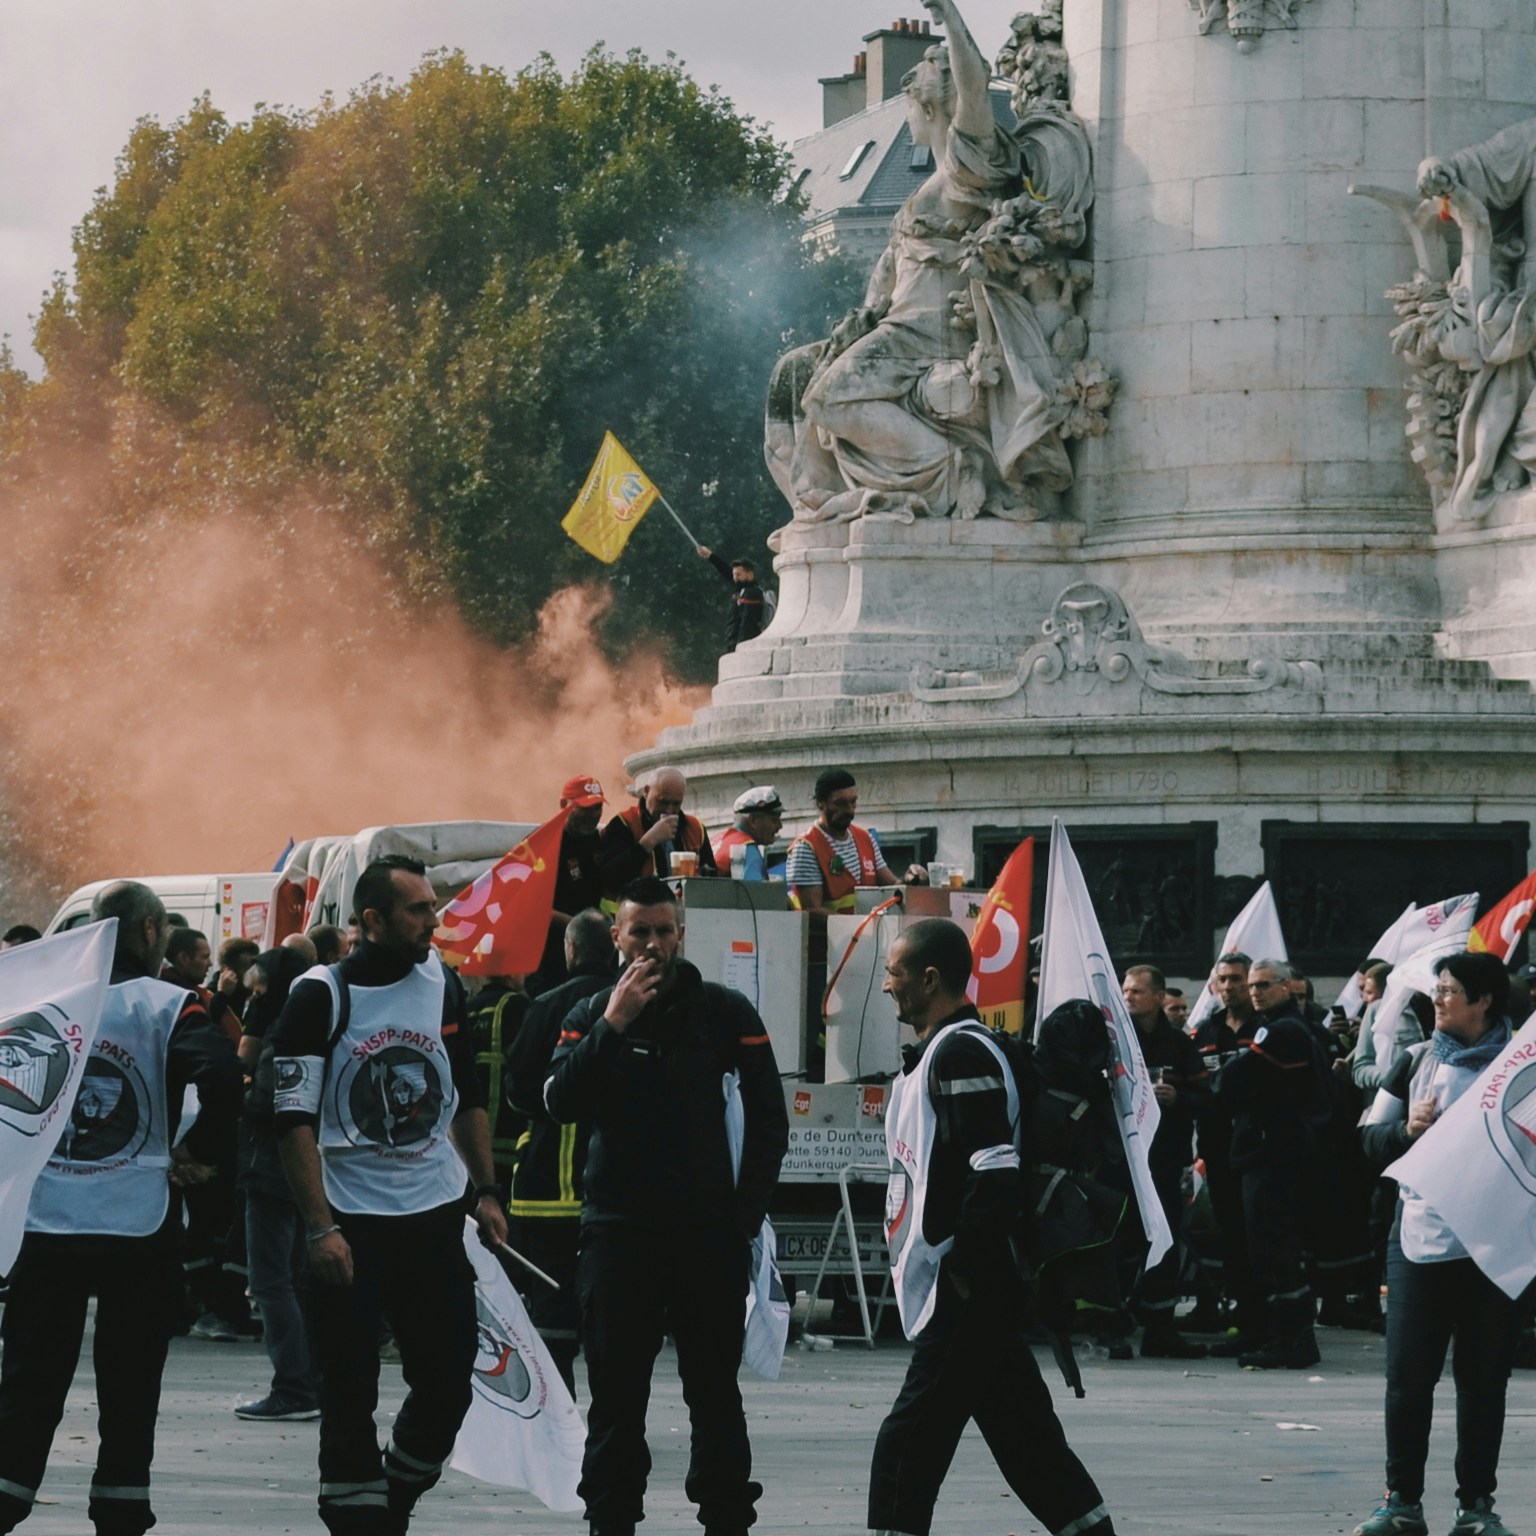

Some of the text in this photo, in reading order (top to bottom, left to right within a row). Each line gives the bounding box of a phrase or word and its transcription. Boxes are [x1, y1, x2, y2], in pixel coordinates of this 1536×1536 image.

[1030, 771, 1121, 794] JUILLET
[1128, 770, 1179, 792] 1790
[1438, 769, 1487, 791] 1792
[352, 1027, 438, 1061] SNSPP-PATS
[95, 1039, 135, 1070] -PATS
[794, 1100, 809, 1111] cgt
[863, 1101, 883, 1115] cgt
[804, 1130, 820, 1142] de
[787, 1146, 810, 1157] ette
[814, 1146, 852, 1157] 59140
